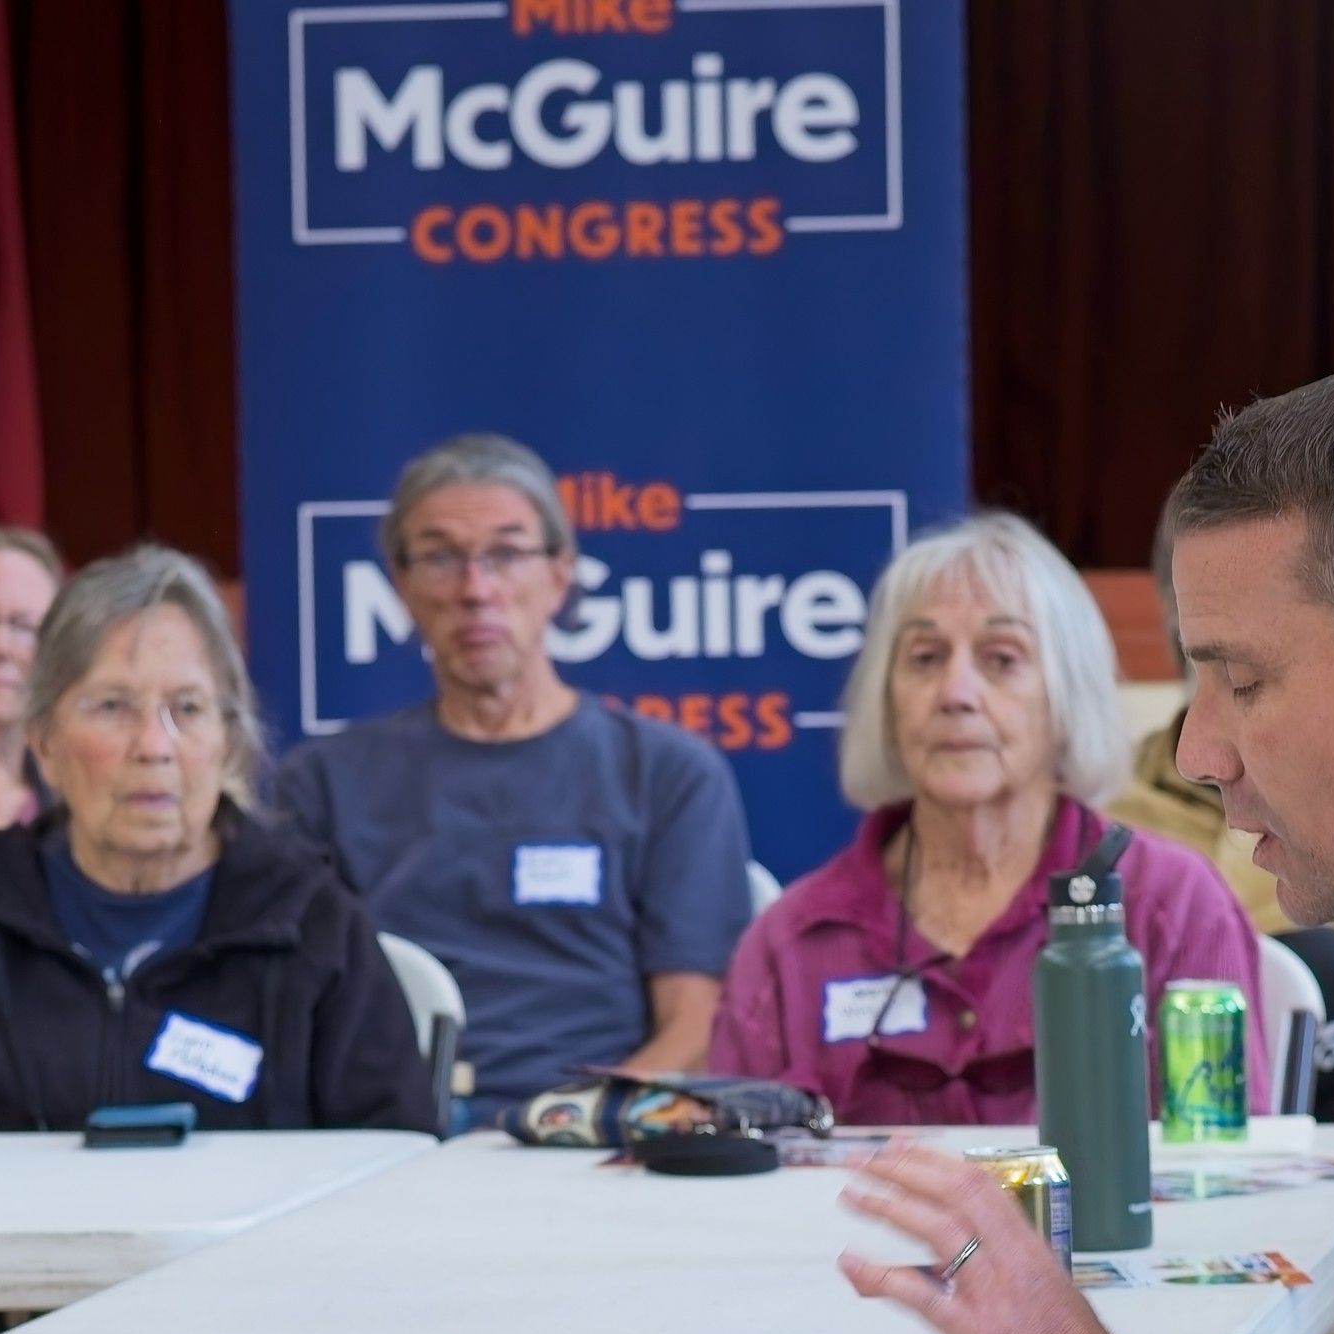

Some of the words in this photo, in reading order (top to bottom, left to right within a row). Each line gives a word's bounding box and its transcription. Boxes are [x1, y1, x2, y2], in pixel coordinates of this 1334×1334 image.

[513, 0, 674, 36] Mike
[333, 52, 861, 172] McGuire
[411, 197, 784, 263] CONGRESS
[342, 549, 866, 665] MGuire
